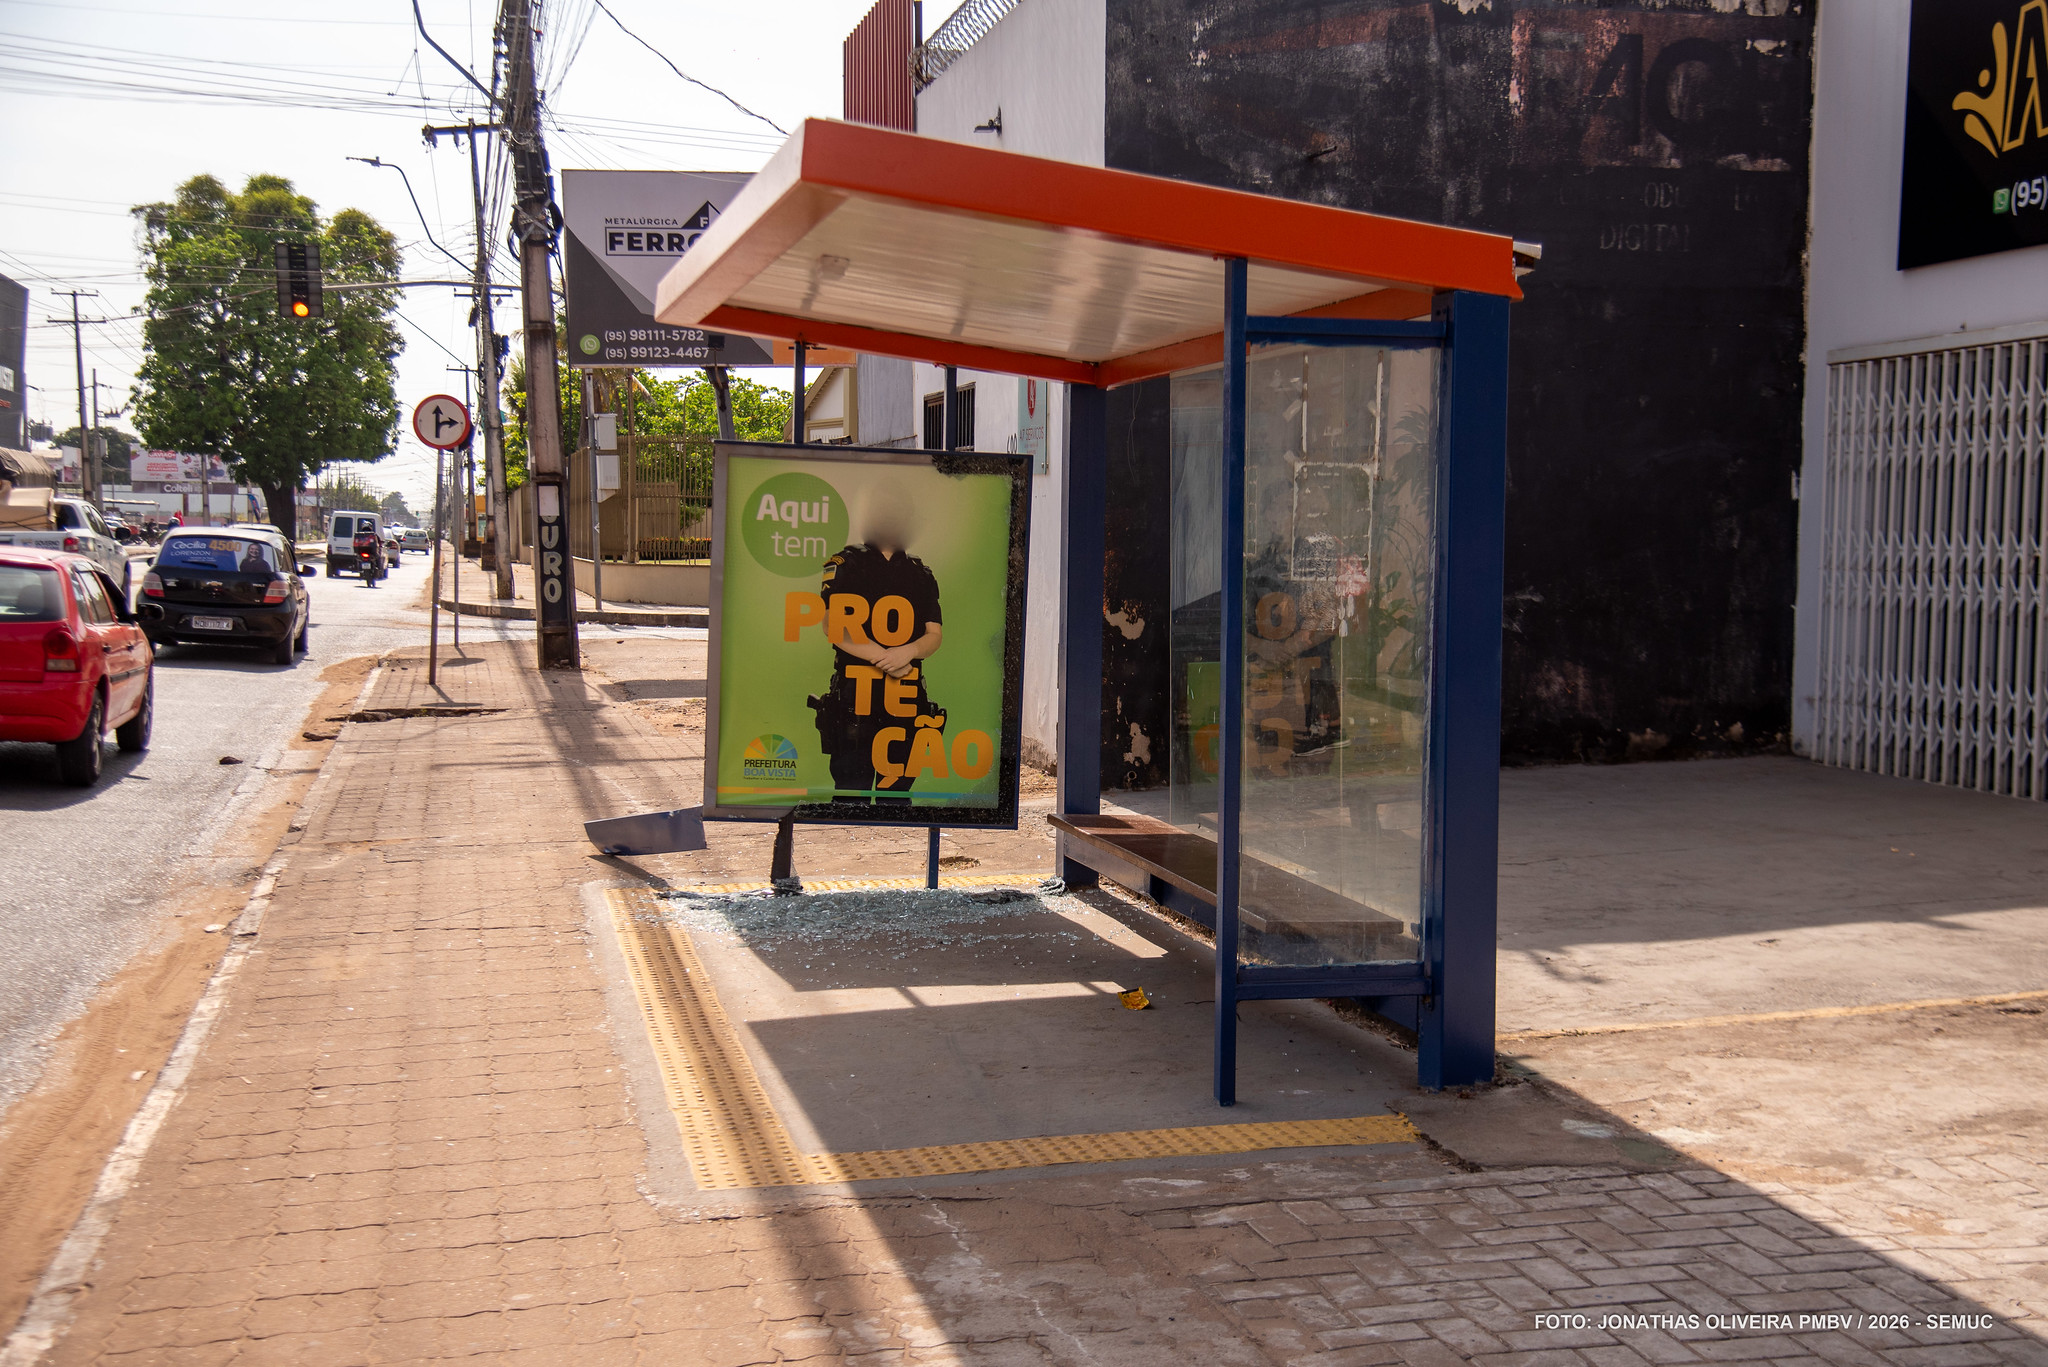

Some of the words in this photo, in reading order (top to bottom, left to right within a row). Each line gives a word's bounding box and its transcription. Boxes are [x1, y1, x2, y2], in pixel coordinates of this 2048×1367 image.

[2011, 176, 2048, 216] (95)
[605, 217, 679, 225] METALÚRGICA
[605, 330, 627, 342] (95)
[629, 329, 704, 341] 98111-5782
[605, 348, 627, 359] (95)
[630, 347, 709, 358] 99123-4467
[756, 494, 829, 529] Aqui
[209, 540, 242, 552] 4500
[771, 531, 827, 558] tem
[784, 591, 914, 646] PRO
[845, 664, 919, 718] TE
[871, 714, 994, 789] ÇÃO
[744, 759, 797, 768] PREFEITURA
[744, 768, 766, 776] BOA
[768, 769, 796, 777] VISTA
